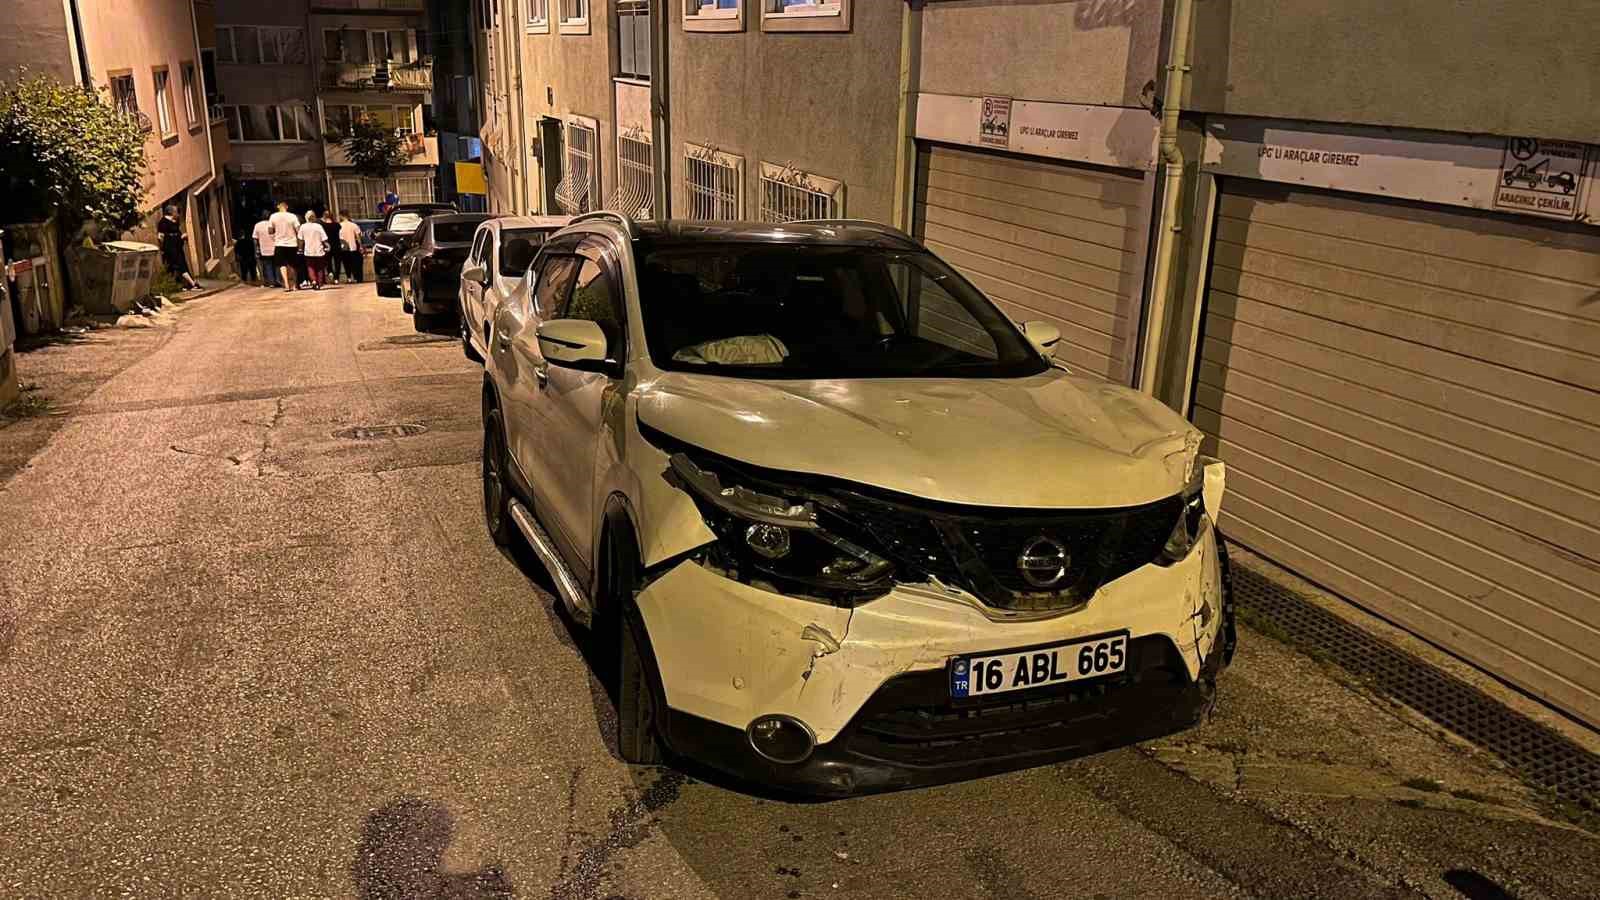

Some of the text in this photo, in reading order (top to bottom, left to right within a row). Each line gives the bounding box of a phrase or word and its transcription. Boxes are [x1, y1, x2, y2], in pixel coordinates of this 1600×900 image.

[1258, 147, 1274, 158] LPG
[1283, 149, 1320, 165] ARAÇLAR
[972, 639, 1125, 692] 16 ABL 665
[955, 680, 968, 690] TR
